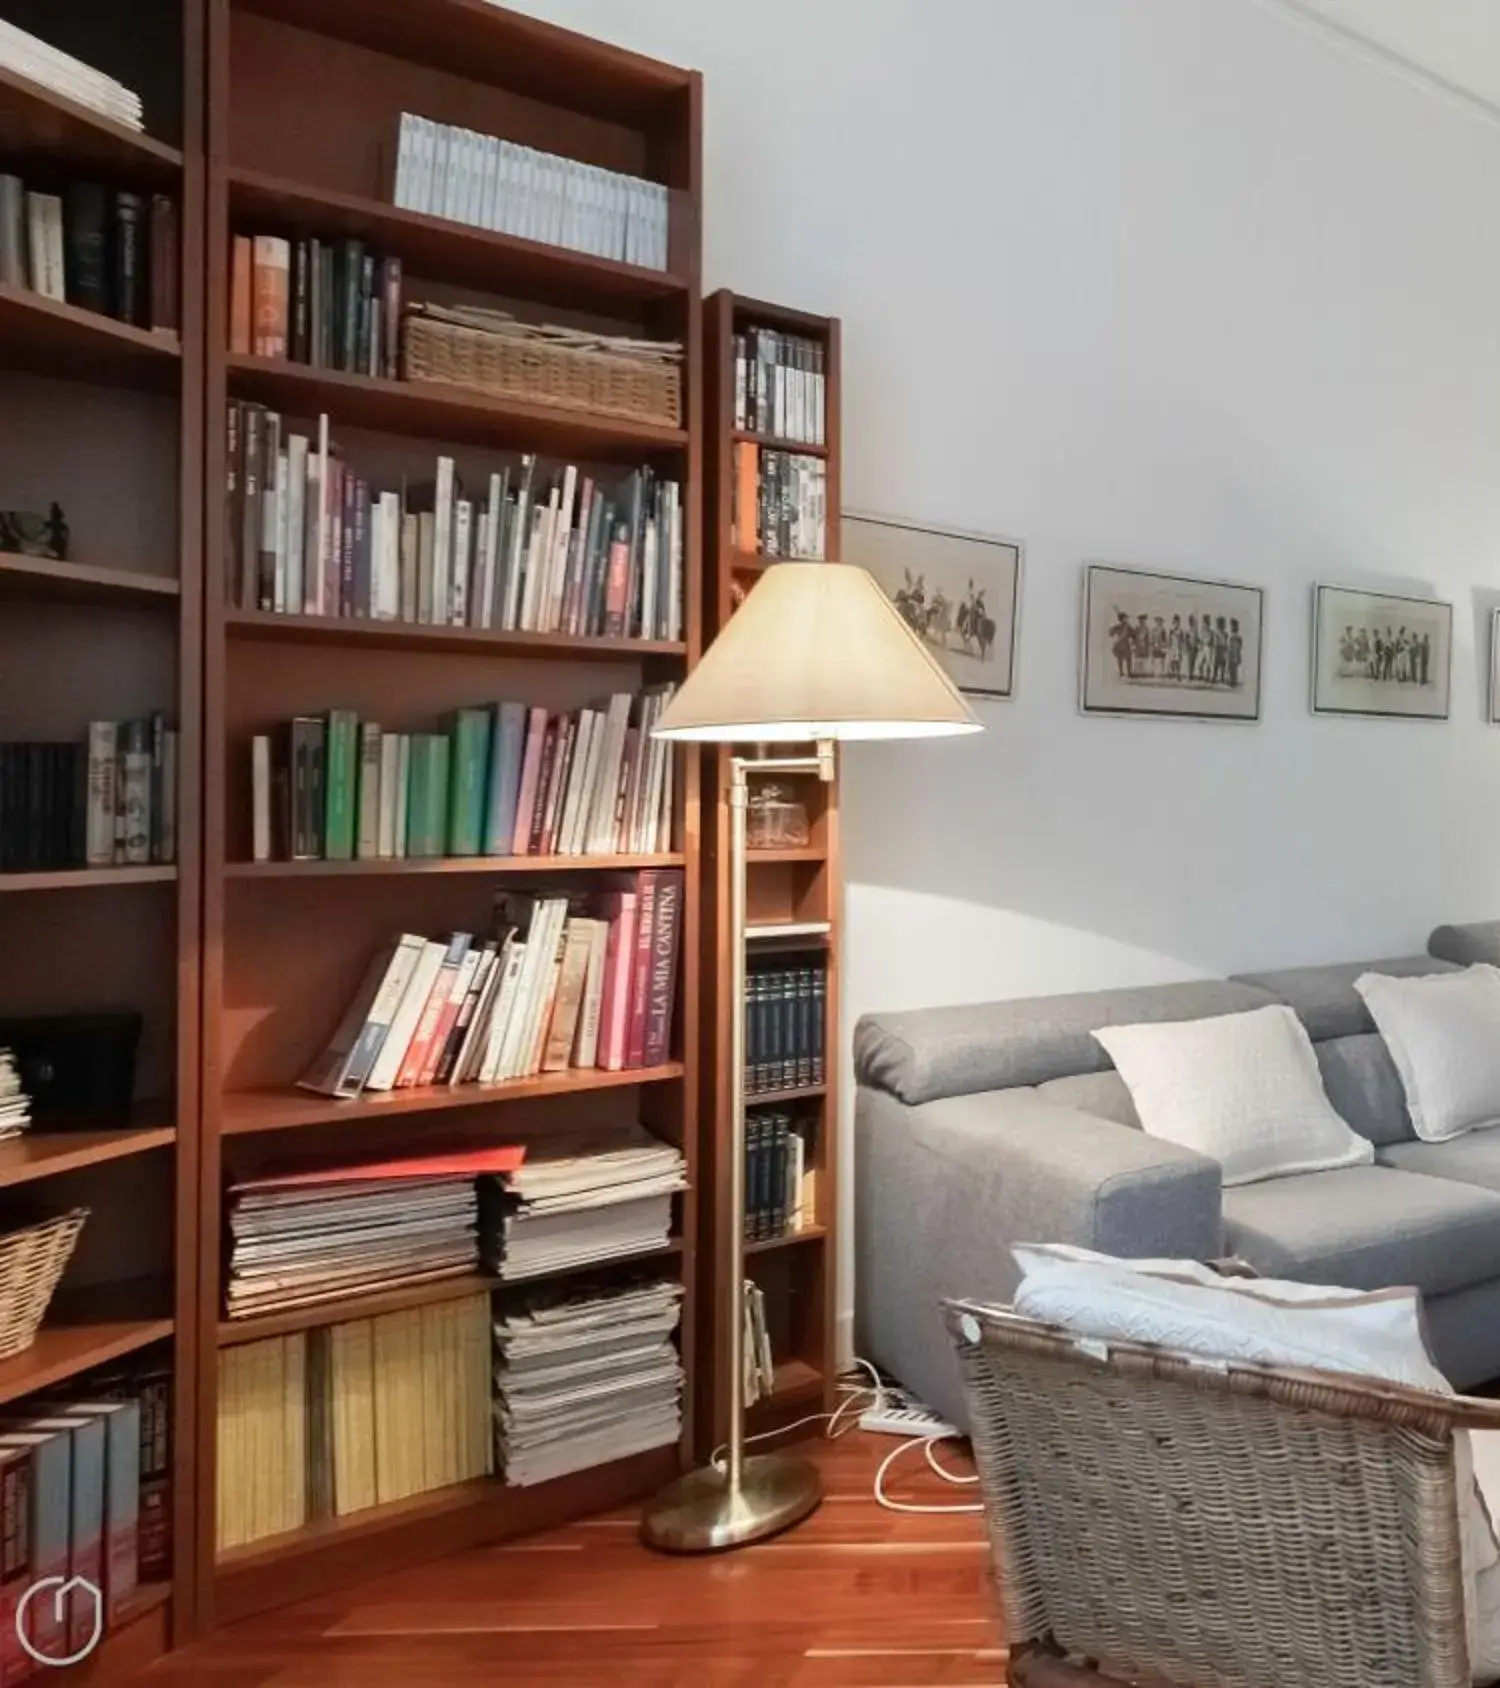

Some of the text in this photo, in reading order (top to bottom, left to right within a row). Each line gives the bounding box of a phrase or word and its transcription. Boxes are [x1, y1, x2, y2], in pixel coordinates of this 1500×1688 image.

[656, 885, 677, 956] CANTINA
[653, 960, 671, 992] MIA
[652, 997, 667, 1015] LA
